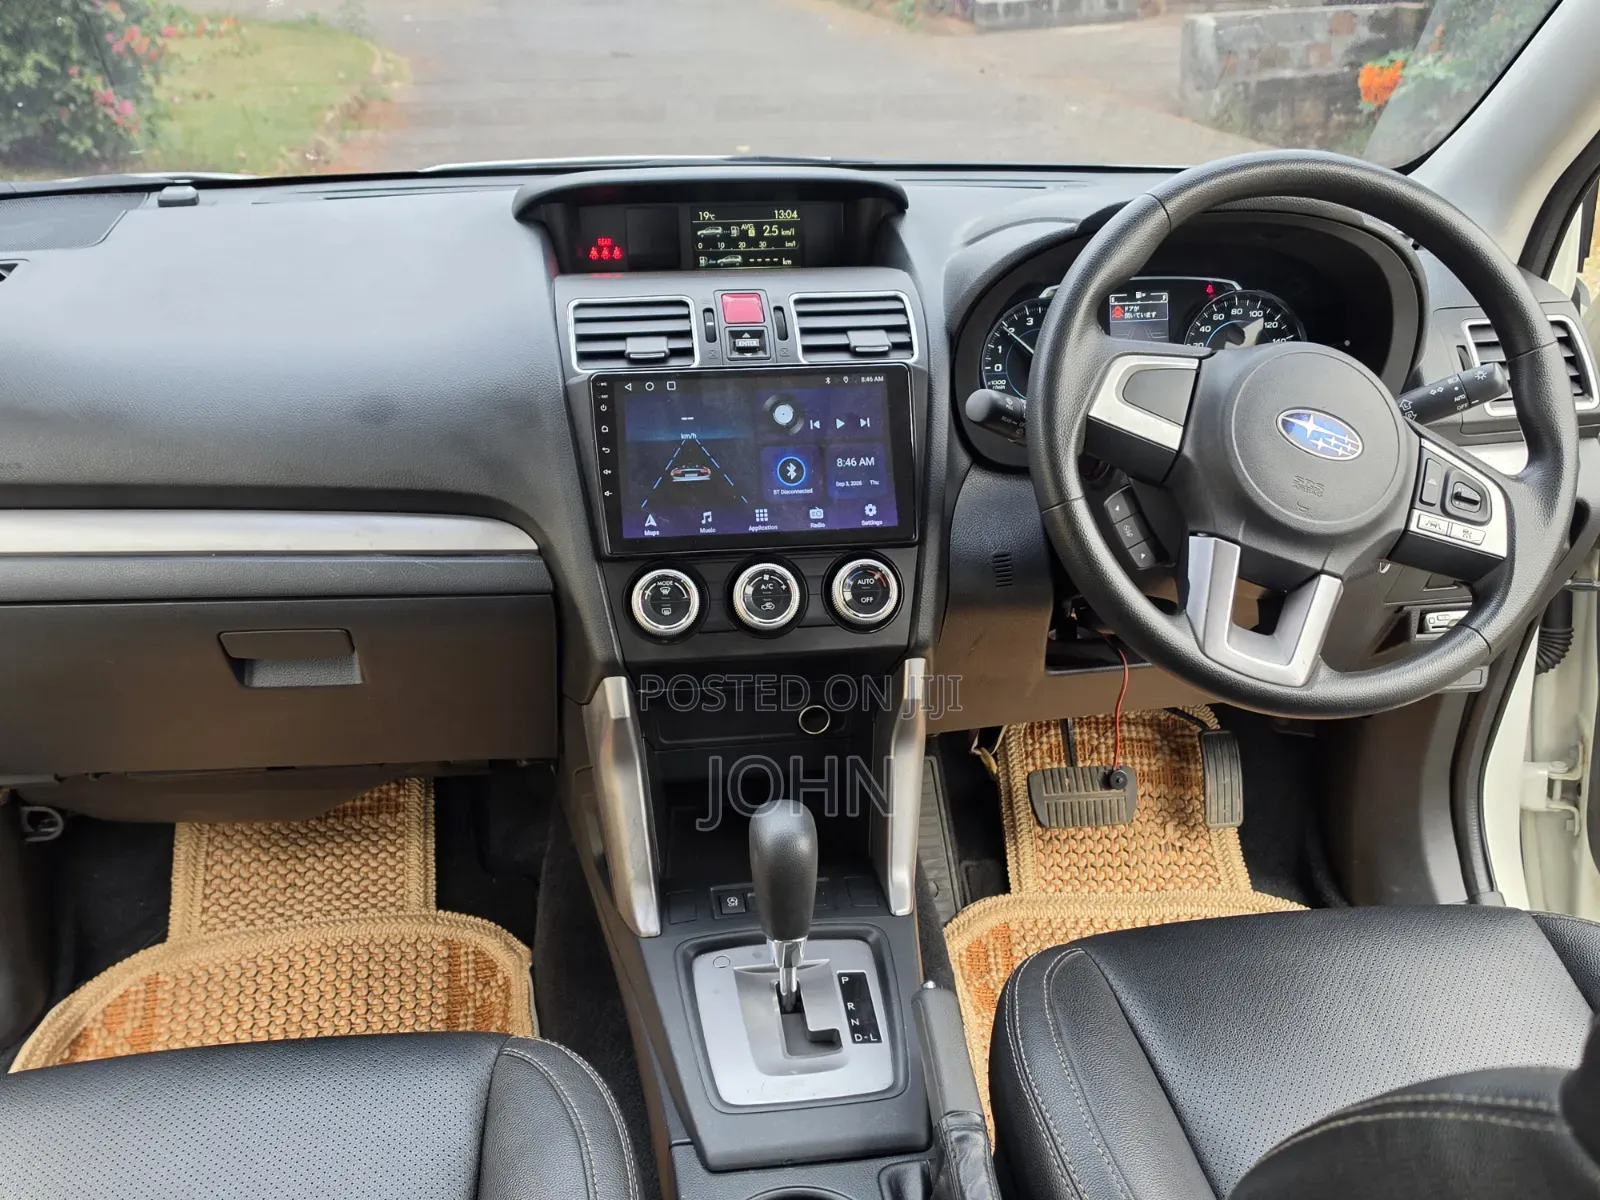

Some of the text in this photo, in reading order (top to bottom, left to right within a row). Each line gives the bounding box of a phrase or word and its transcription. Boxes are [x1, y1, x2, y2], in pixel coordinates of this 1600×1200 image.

[774, 209, 798, 219] 13:04
[763, 224, 779, 236] 2.5
[738, 241, 746, 249] 20
[782, 257, 792, 265] km
[1212, 313, 1225, 321] 60
[1249, 310, 1264, 318] 100
[1026, 317, 1034, 326] 3
[1264, 321, 1279, 329] 120
[997, 345, 1003, 354] 1
[994, 363, 1002, 372] 0
[680, 432, 697, 440] km/h
[836, 456, 875, 468] 8:46 AM
[835, 480, 846, 488] Sep
[780, 487, 813, 495] Disconnected
[644, 529, 660, 537] Maps
[841, 976, 849, 985] P
[847, 1002, 856, 1011] R
[850, 1018, 860, 1027] N
